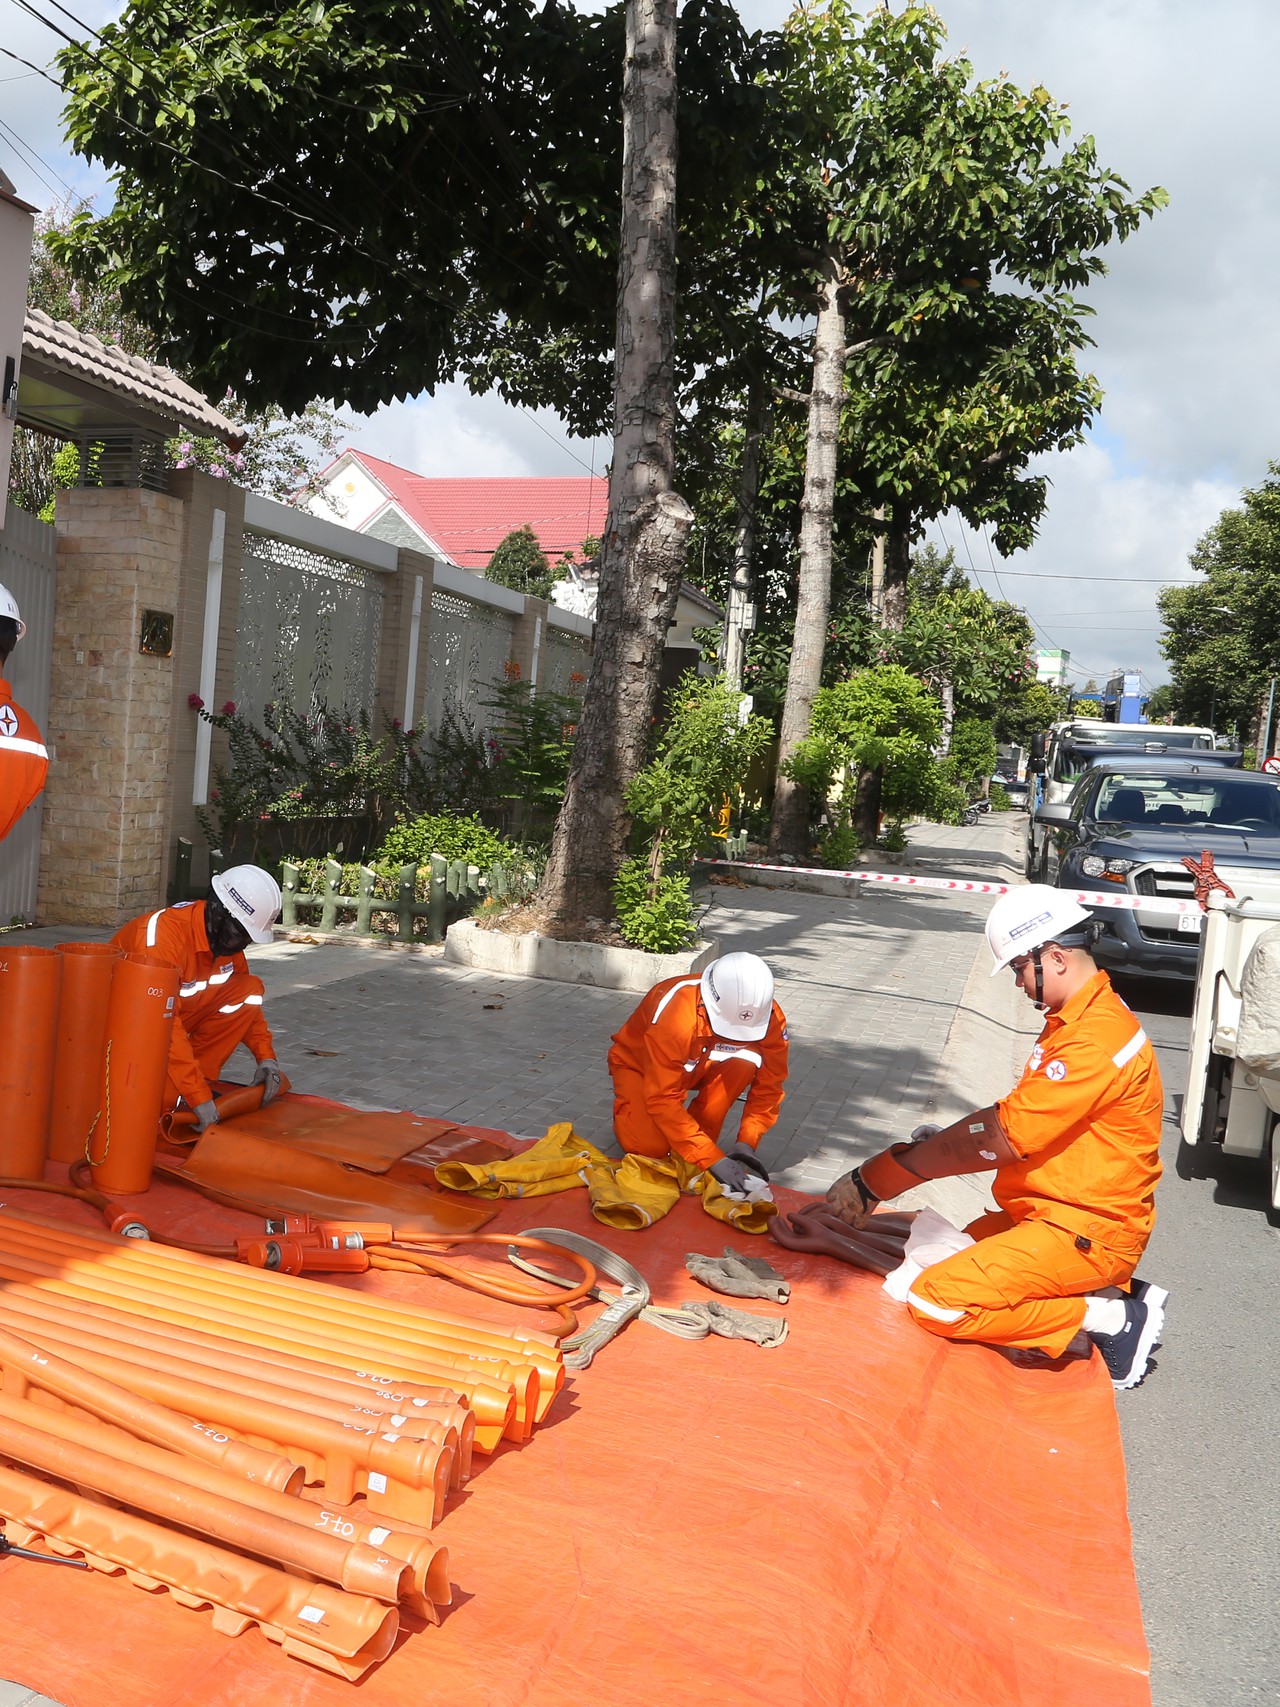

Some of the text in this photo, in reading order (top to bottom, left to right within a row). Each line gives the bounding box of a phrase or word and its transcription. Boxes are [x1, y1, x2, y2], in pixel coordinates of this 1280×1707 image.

[1181, 916, 1197, 930] 61
[147, 986, 164, 998] 003
[315, 1511, 354, 1537] 075
